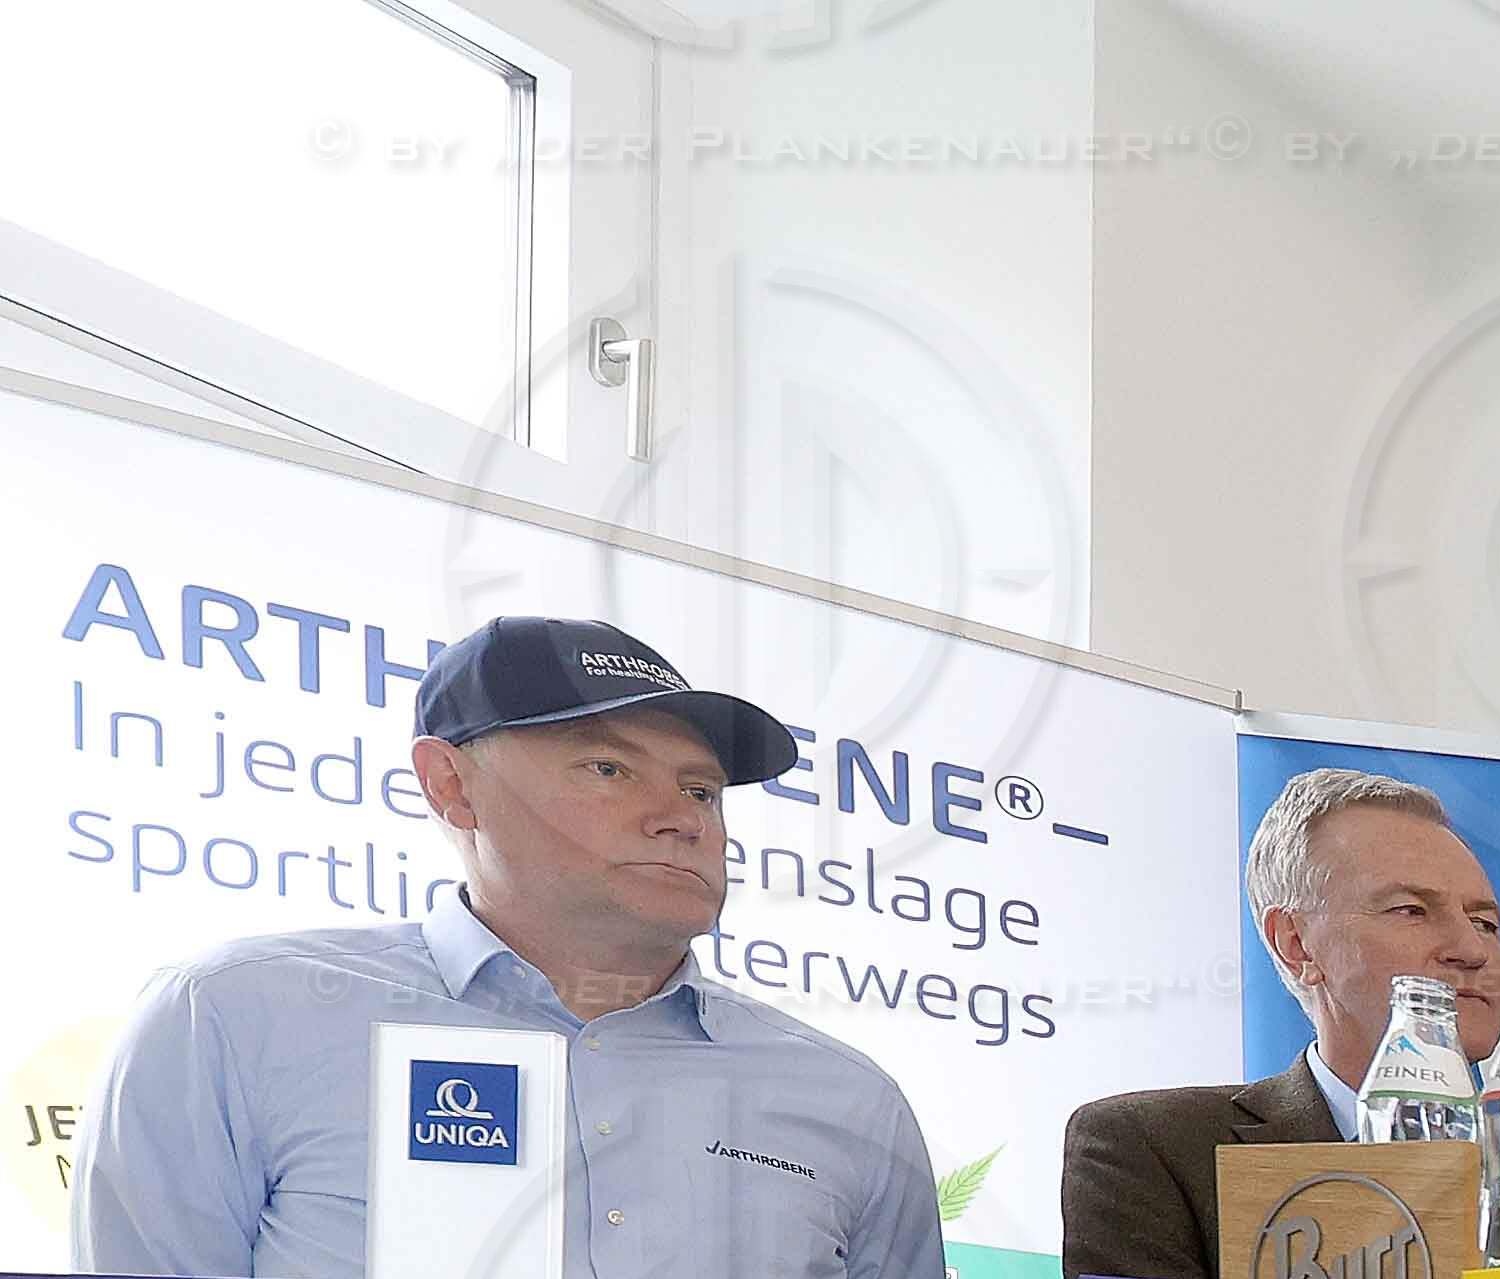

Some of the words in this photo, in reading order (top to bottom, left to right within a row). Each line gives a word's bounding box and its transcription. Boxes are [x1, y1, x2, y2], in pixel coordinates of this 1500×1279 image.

[61, 561, 1044, 845] ARTHENE®
[73, 680, 164, 768] In
[200, 712, 429, 820] jede
[726, 838, 1039, 950] nslage
[67, 808, 457, 917] sportli
[707, 920, 1056, 1046] terwegs
[414, 1120, 510, 1151] UNIQA
[719, 1147, 816, 1180] ARTHROBENE
